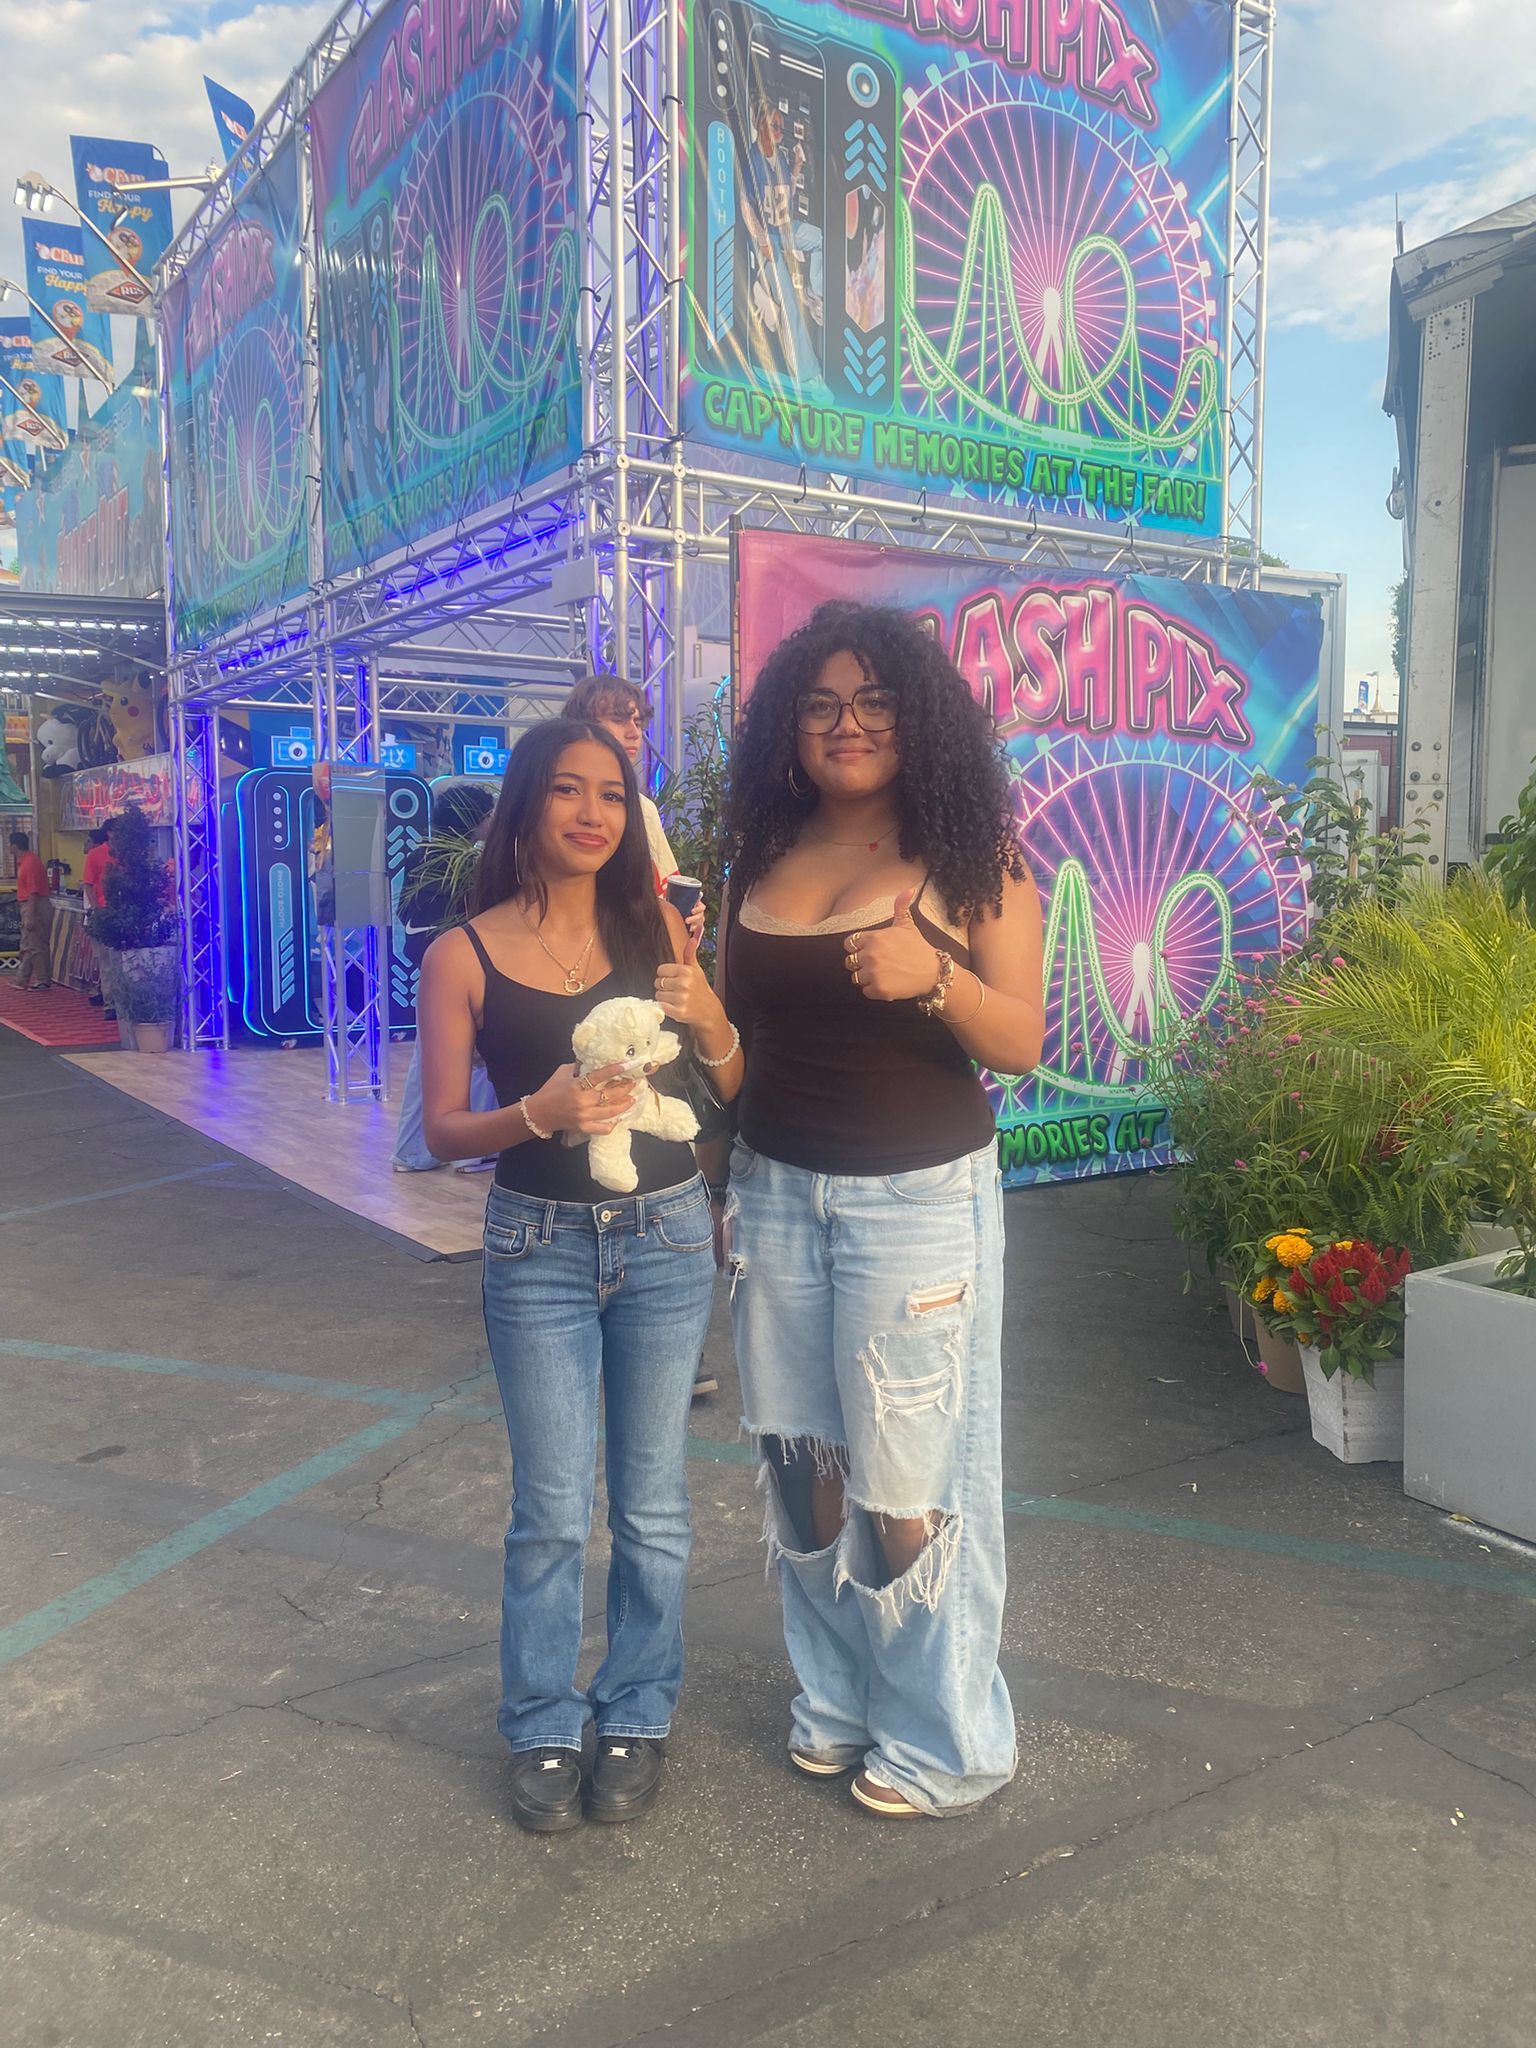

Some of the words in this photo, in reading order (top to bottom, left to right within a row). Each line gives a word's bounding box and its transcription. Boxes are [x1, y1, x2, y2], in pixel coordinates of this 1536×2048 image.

[715, 127, 727, 226] BOOTH
[97, 199, 153, 222] Hapy
[58, 268, 83, 280] YOUR
[704, 383, 865, 456] CAPTURE
[874, 421, 1026, 488] MEMORIES
[1030, 455, 1074, 496] AT
[1080, 462, 1137, 508] THE
[1142, 473, 1207, 520] FAIR!
[277, 869, 285, 898] PHOTO
[278, 899, 286, 929] BOOTH
[996, 1114, 1110, 1170] MORIES
[1115, 1108, 1167, 1153] AT
